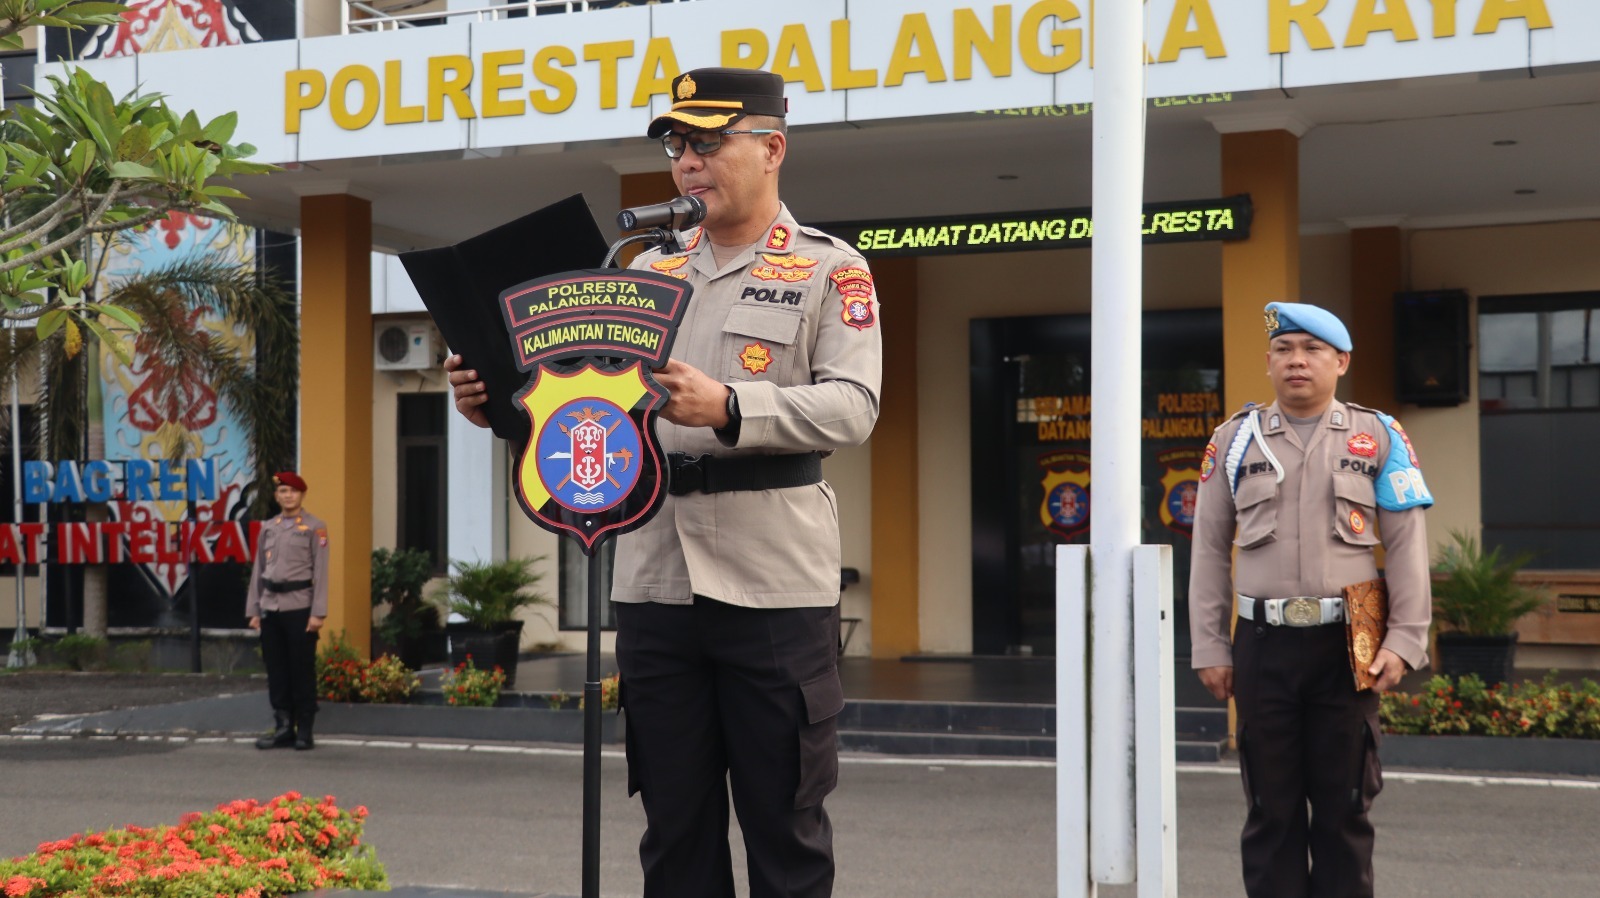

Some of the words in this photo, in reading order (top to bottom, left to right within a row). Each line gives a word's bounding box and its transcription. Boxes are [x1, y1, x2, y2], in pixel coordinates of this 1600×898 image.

[284, 38, 682, 134] POLRESTA
[720, 0, 1228, 93] PALANGA
[856, 224, 965, 251] SELAMAT
[967, 219, 1066, 246] DATANG
[1142, 208, 1234, 235] LRESTA
[548, 281, 639, 299] POLRESTA
[741, 286, 802, 306] POLRI
[528, 294, 613, 316] PALANGKA
[616, 294, 656, 311] RAYA
[523, 323, 604, 355] KALIMANTAN
[606, 323, 660, 351] TENGAH
[1157, 392, 1220, 413] POLRESTA
[24, 460, 112, 503] BAG
[127, 459, 216, 501] REN
